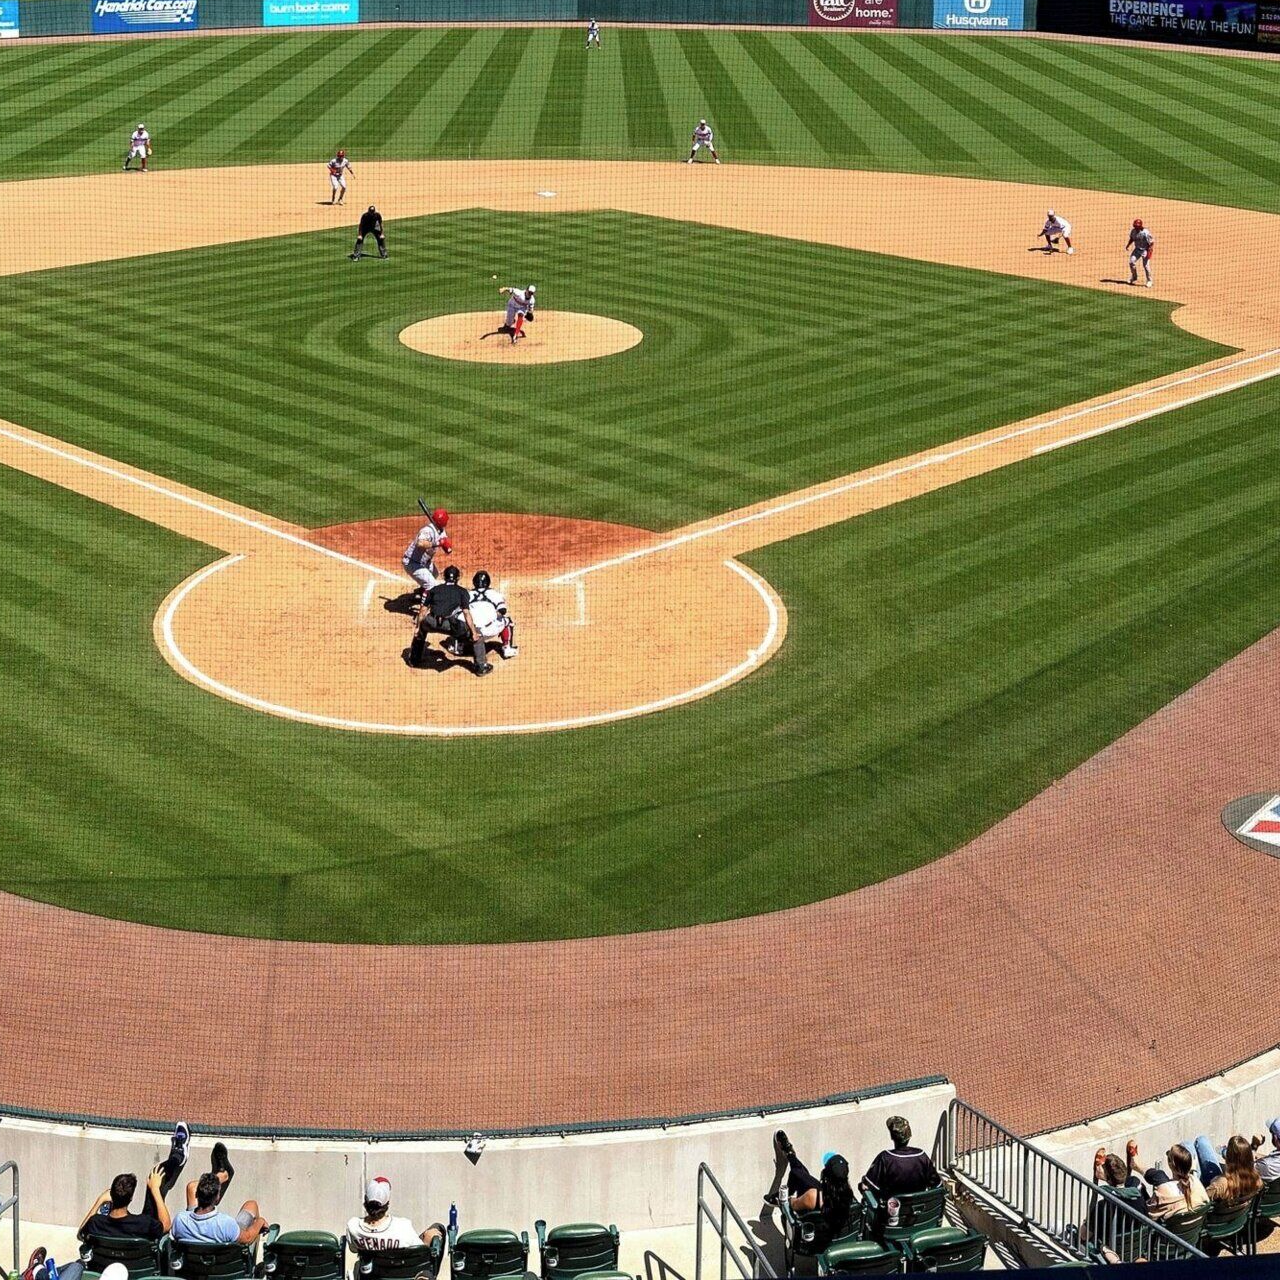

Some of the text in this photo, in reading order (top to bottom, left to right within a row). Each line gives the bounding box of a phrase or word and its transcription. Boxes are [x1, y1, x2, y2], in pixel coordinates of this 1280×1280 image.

[322, 3, 350, 15] camp
[1109, 0, 1184, 17] EXPERIENCE
[946, 14, 1009, 28] Husqvarna
[1110, 13, 1255, 35] THE GAME. THE VIEW. THE FUN.
